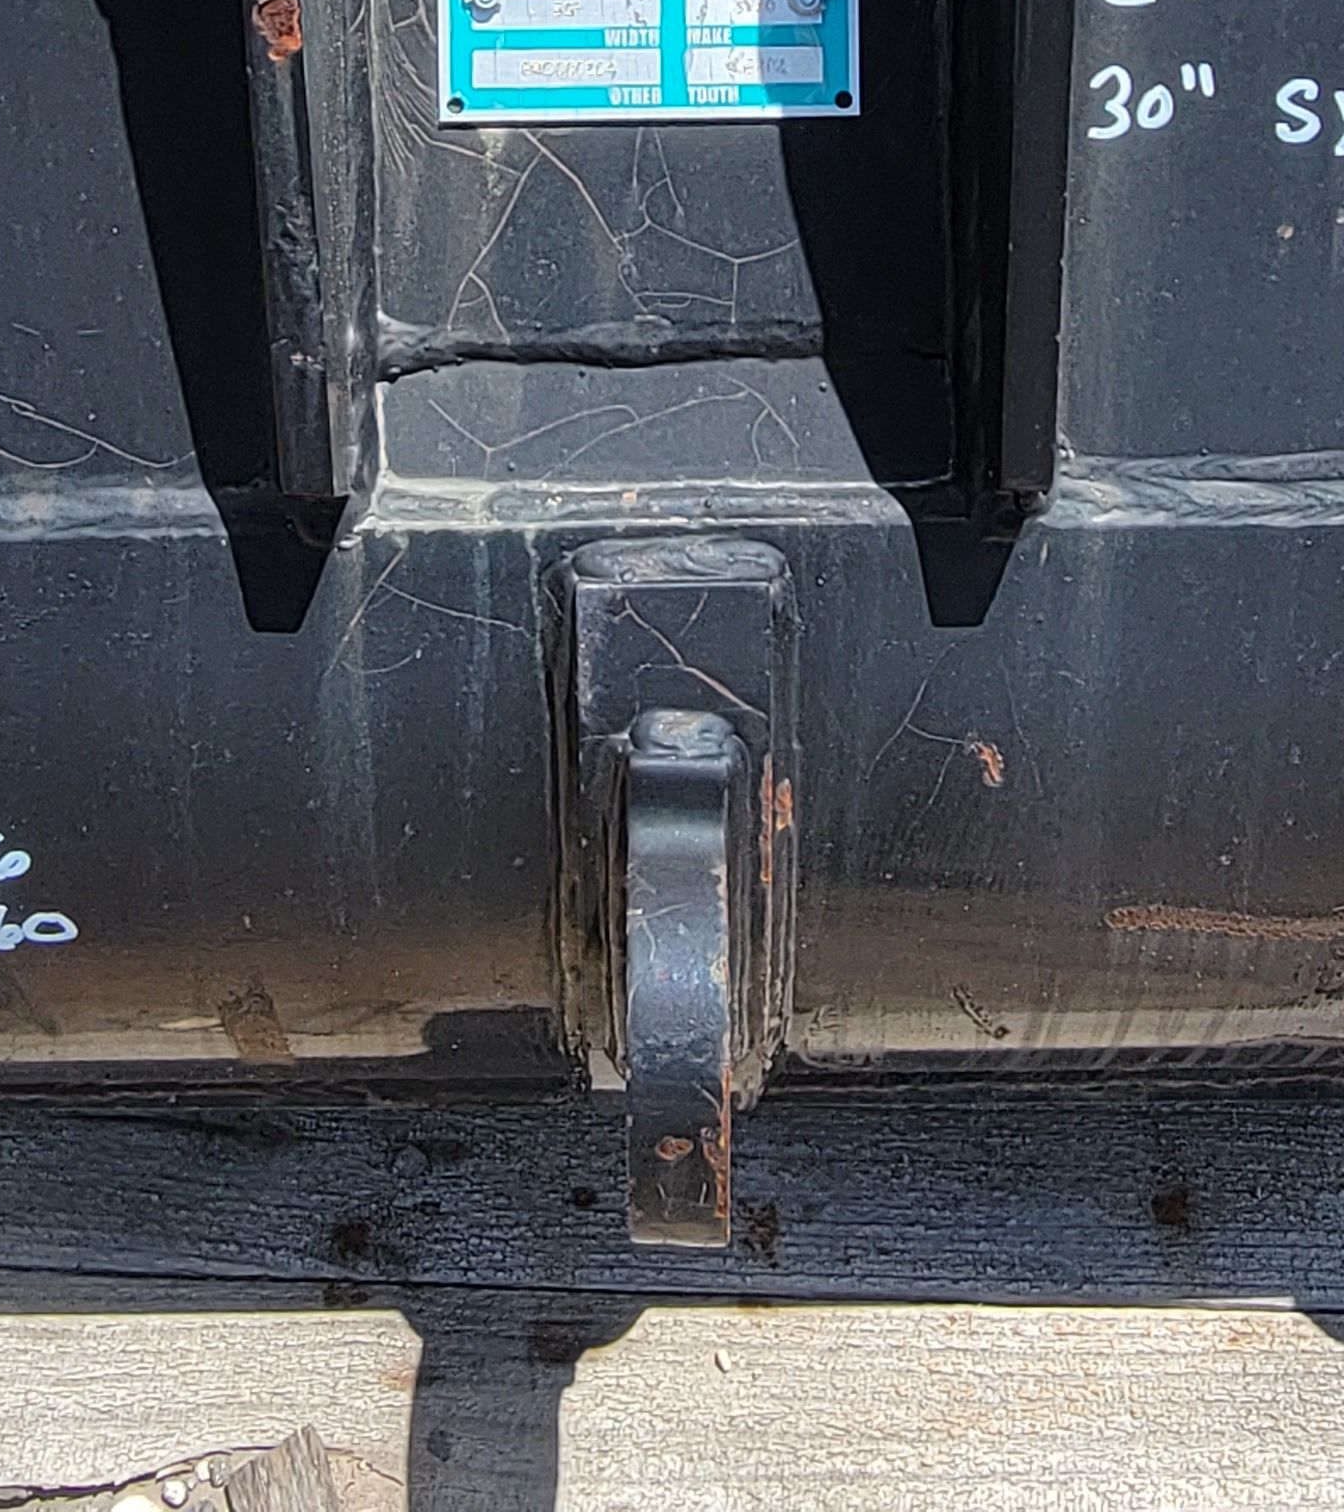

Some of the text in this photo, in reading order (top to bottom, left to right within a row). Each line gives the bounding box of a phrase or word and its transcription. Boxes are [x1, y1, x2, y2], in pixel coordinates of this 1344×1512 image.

[604, 28, 660, 47] WIDTH
[687, 26, 732, 44] MAKE
[609, 87, 662, 105] OTHER
[689, 85, 739, 104] TOOTH
[1088, 63, 1215, 140] 30"
